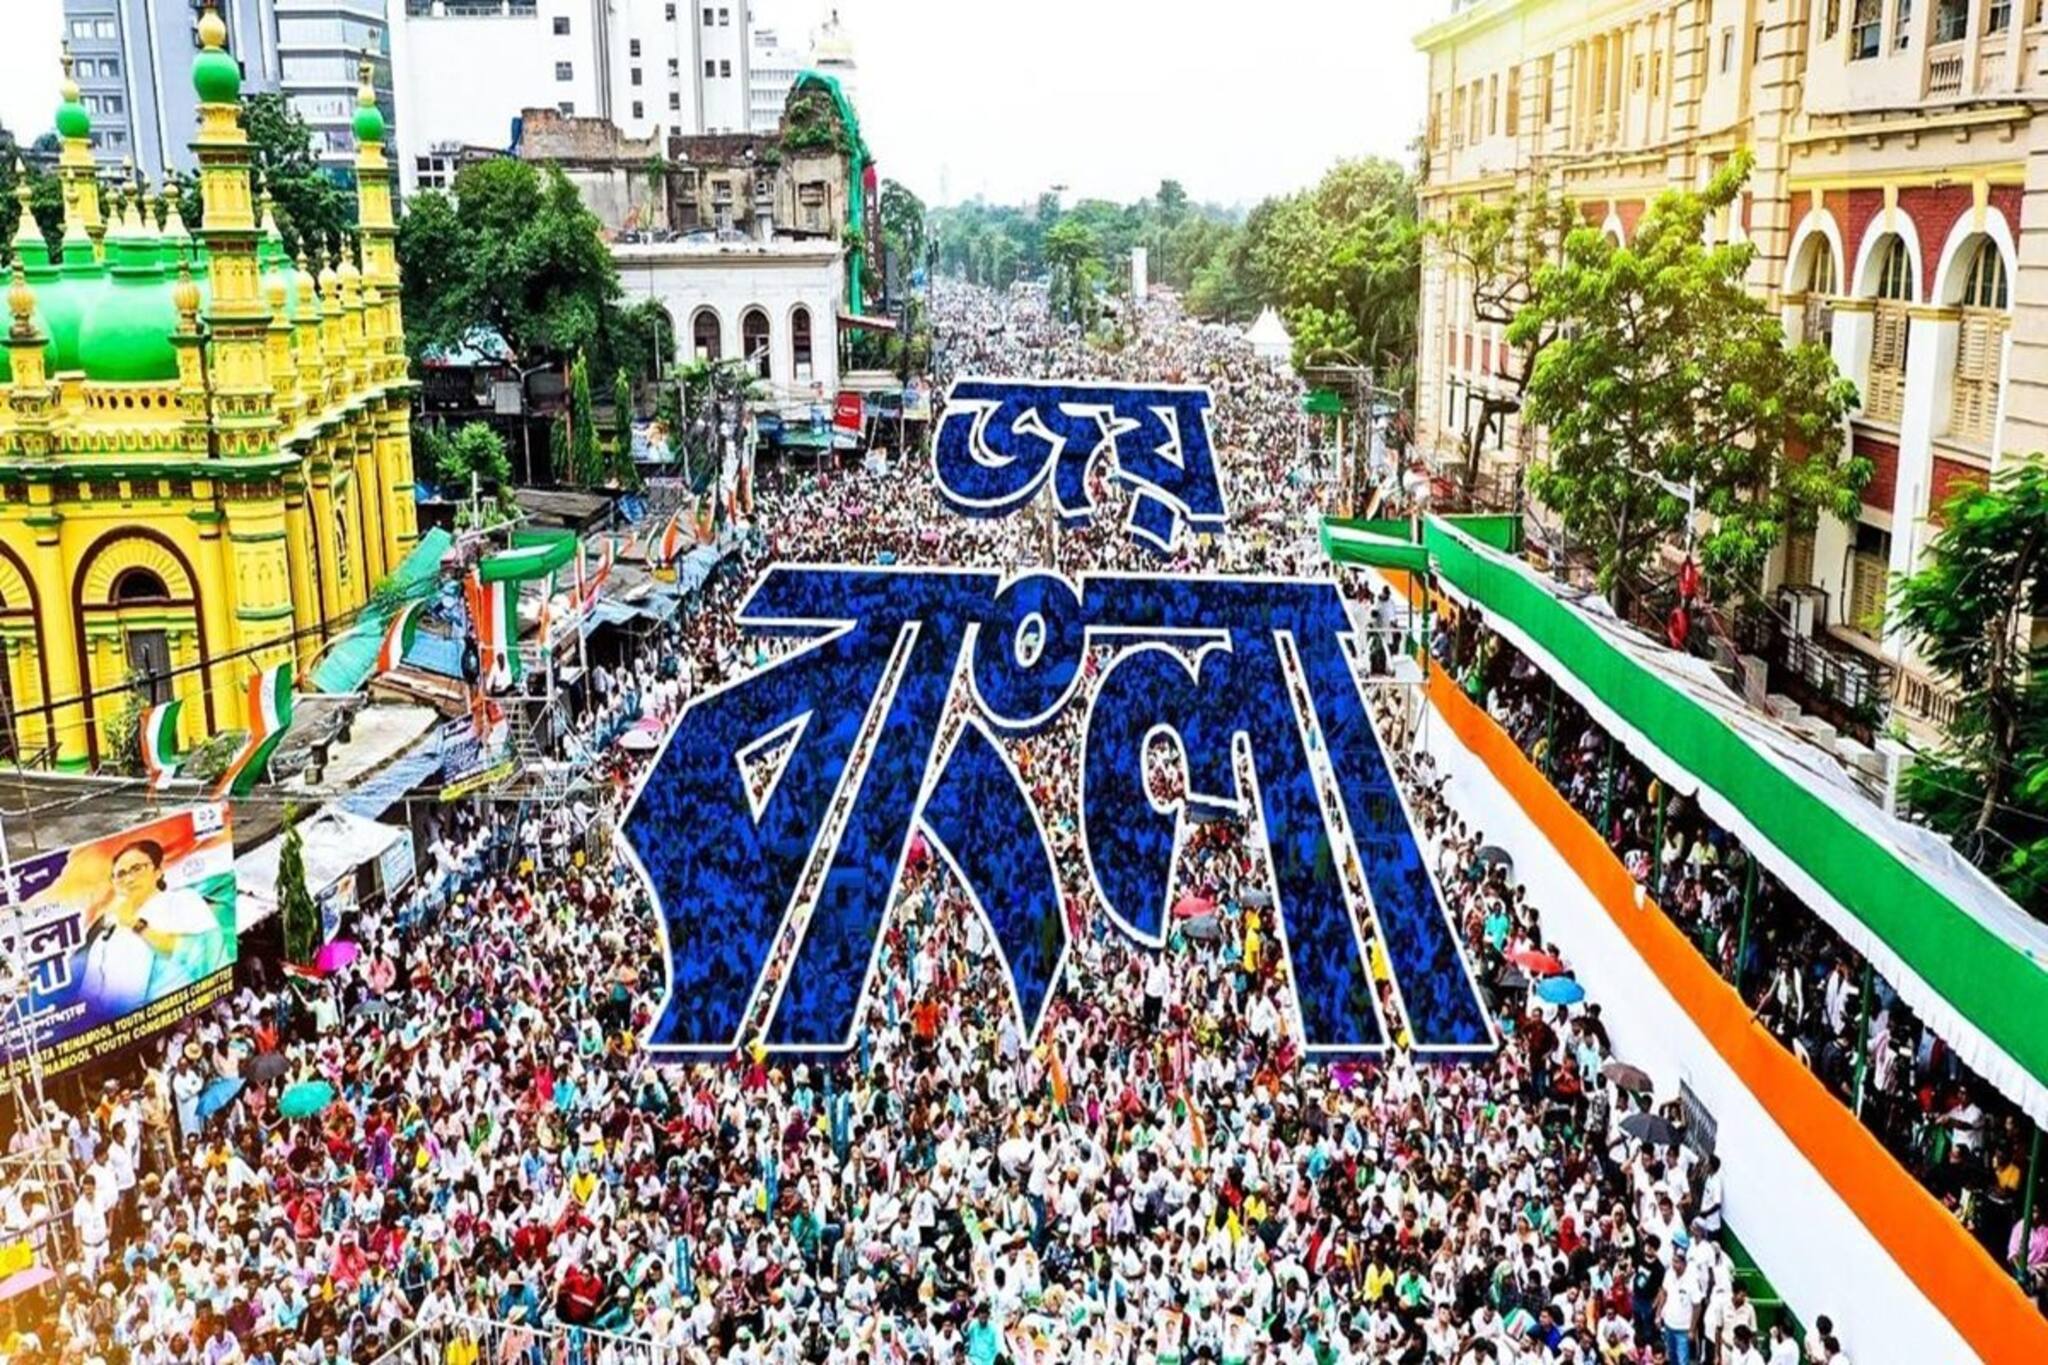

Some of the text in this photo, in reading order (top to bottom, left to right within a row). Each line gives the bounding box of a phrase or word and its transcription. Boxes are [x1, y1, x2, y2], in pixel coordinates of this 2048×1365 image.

[866, 194, 876, 270] METRO
[9, 1046, 56, 1076] OLTA
[115, 1009, 146, 1031] YOUTH
[146, 988, 189, 1018] CONGRESS
[190, 967, 233, 997] COMMITTEE
[25, 1048, 93, 1084] TNAMOOL
[94, 1031, 131, 1057] YOUTH
[132, 1005, 184, 1040] CONGRESS
[185, 979, 234, 1014] COMMITTEE
